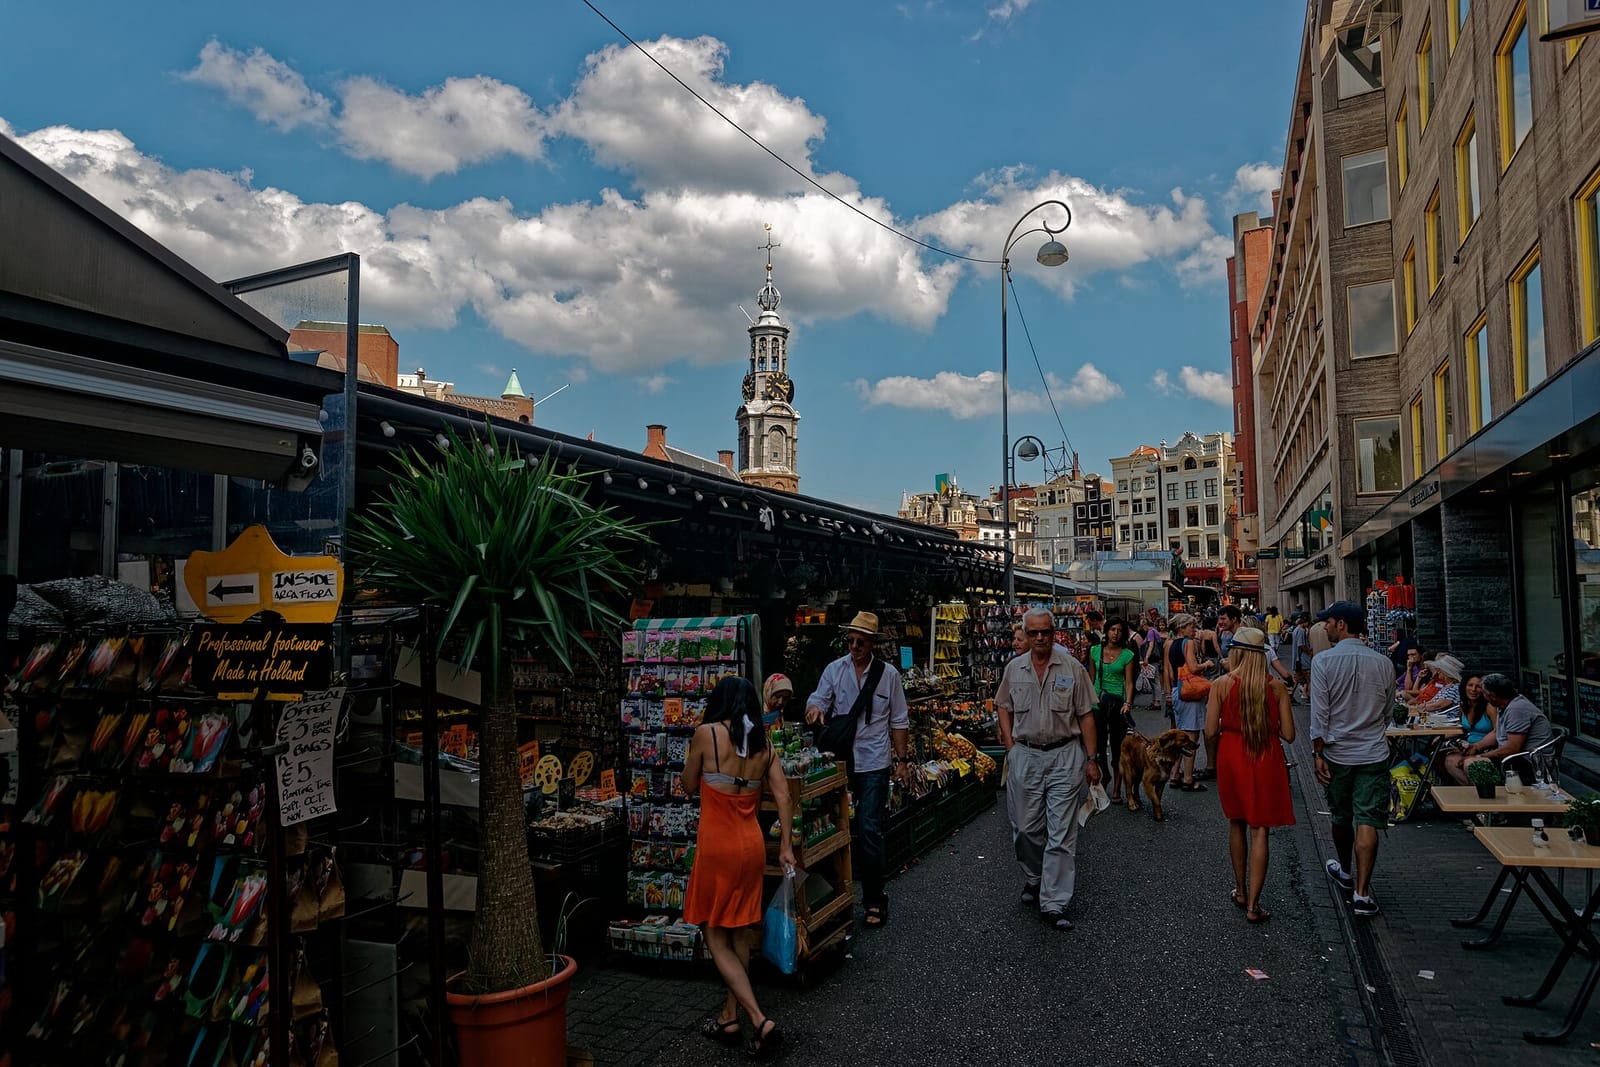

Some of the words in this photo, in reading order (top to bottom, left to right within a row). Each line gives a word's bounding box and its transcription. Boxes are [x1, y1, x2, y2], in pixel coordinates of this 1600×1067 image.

[198, 630, 272, 658] Professional
[271, 630, 325, 658] footwear
[211, 658, 248, 682] Made
[247, 664, 258, 682] in
[259, 658, 309, 682] Holland
[283, 701, 333, 721] OFFER
[293, 739, 332, 757] BAGS
